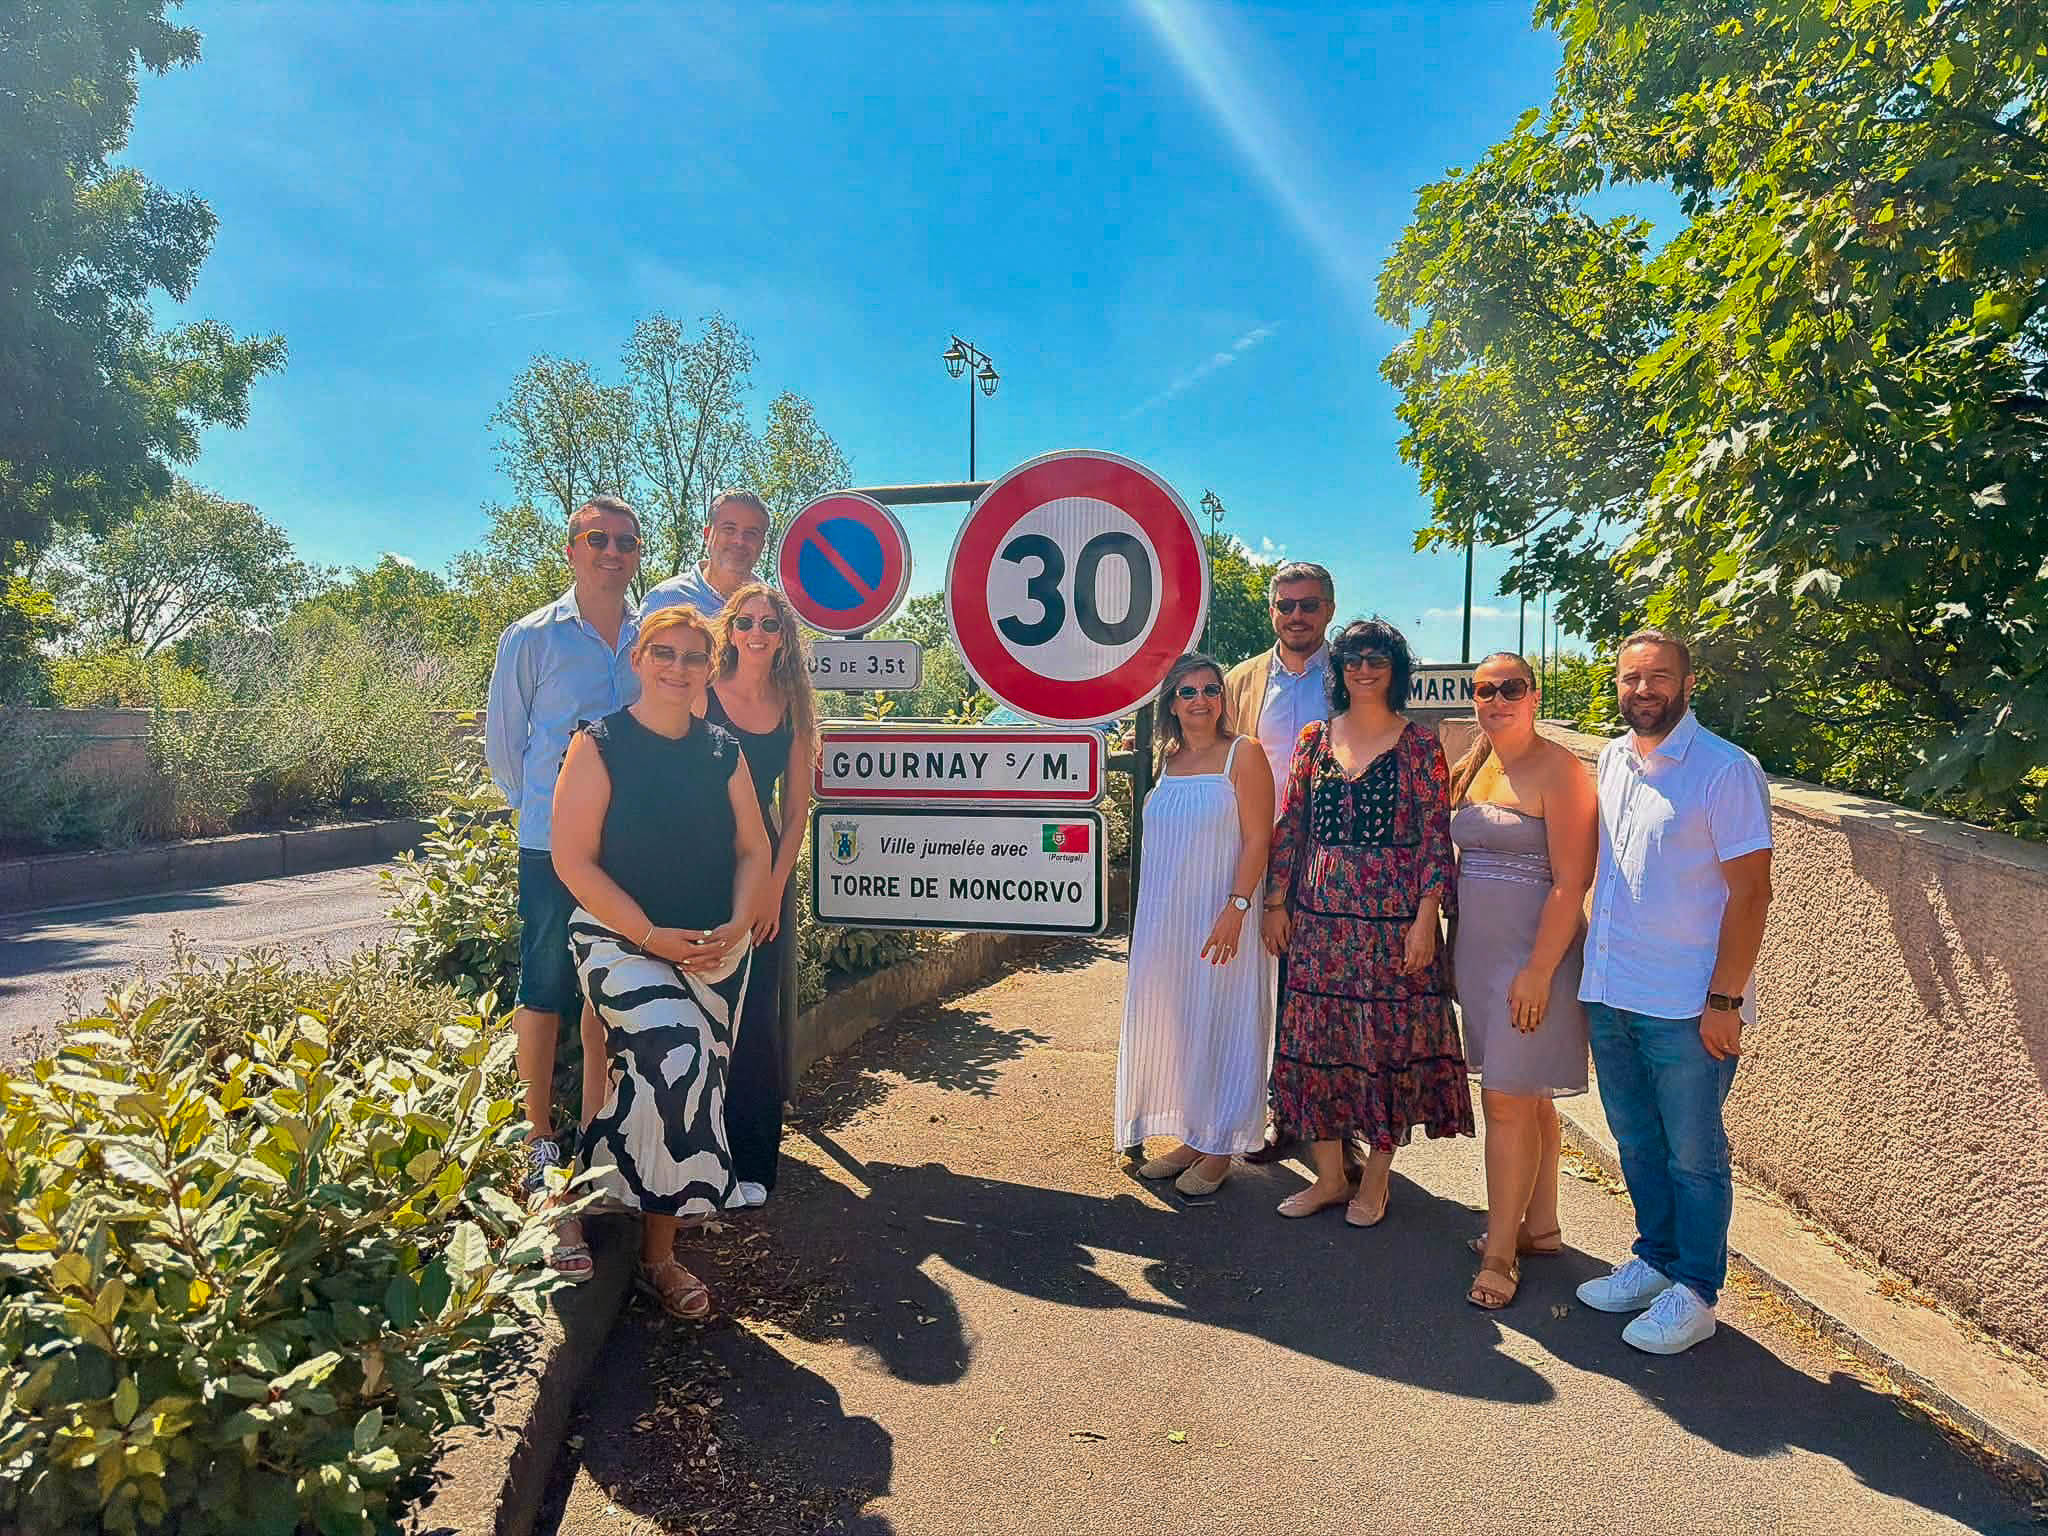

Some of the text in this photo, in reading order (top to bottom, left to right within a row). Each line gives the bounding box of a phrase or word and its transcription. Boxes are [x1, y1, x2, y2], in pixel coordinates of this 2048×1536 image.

[997, 531, 1153, 646] 30
[840, 661, 857, 673] DE
[867, 655, 905, 675] 3,5t
[832, 752, 988, 779] GOURNAY
[880, 836, 1028, 860] Ville jumelée avec
[1048, 853, 1083, 863] (Portugal)
[831, 874, 1082, 903] TORRE DE MONCORVO
